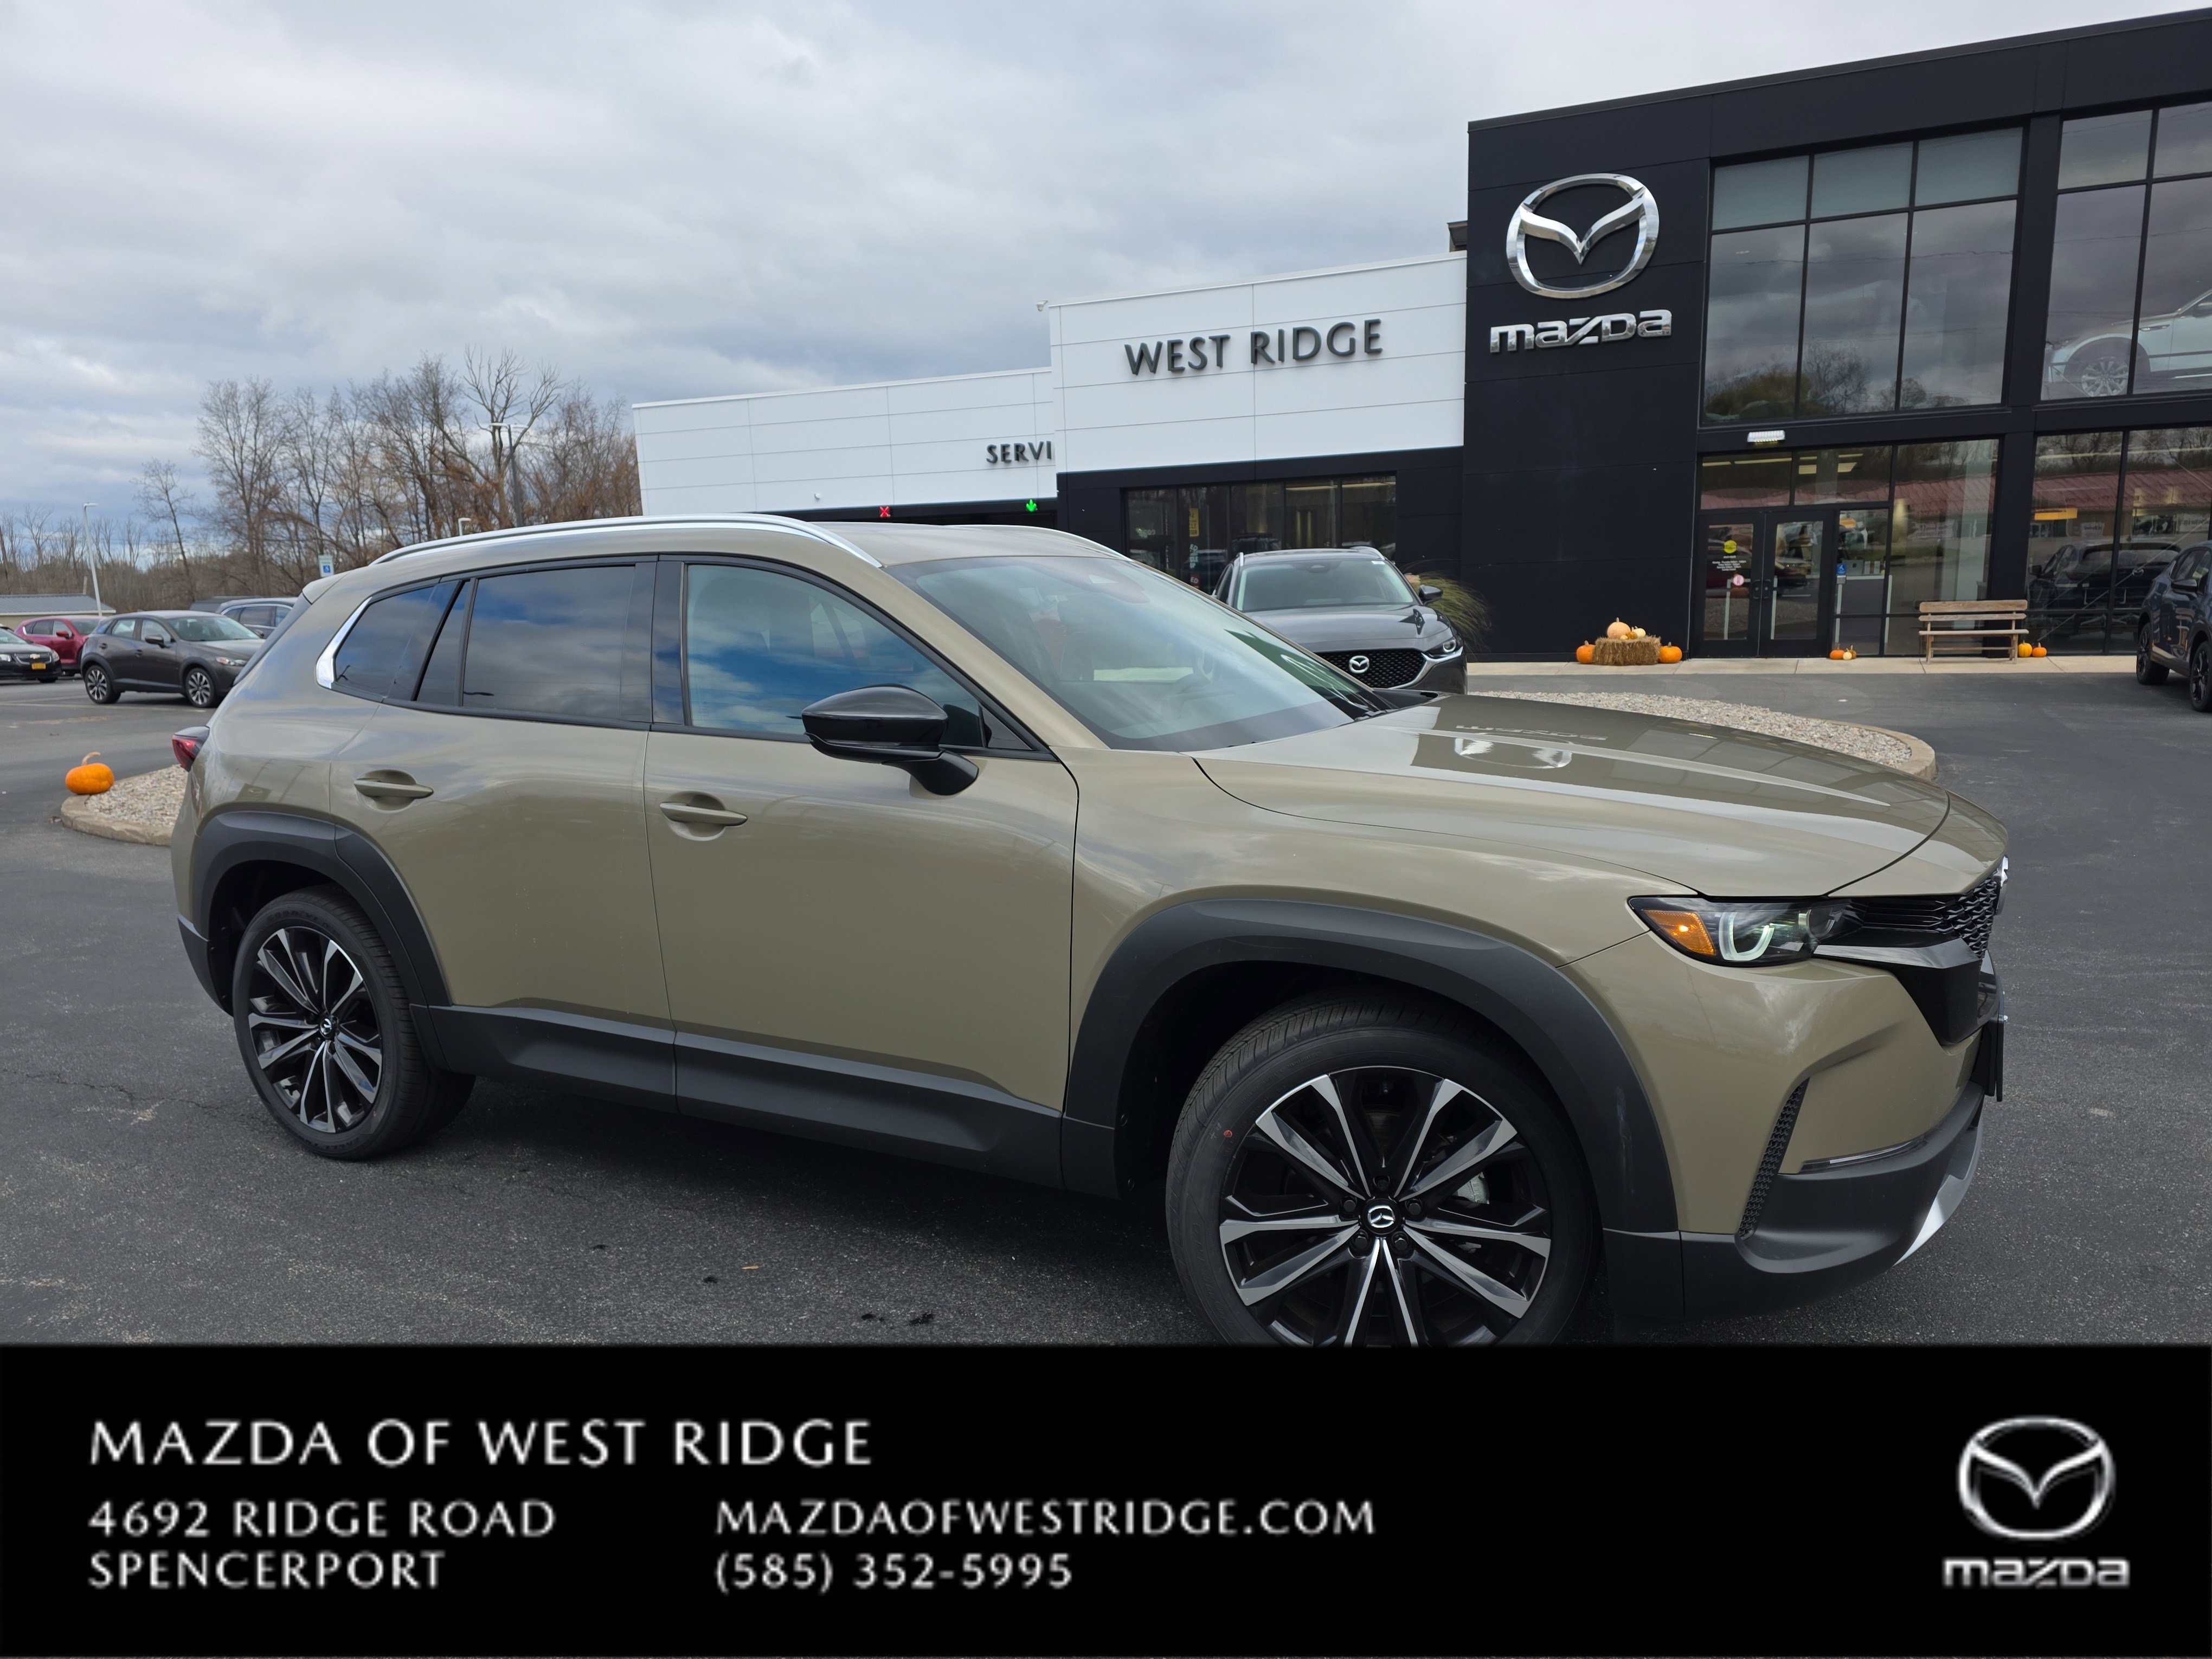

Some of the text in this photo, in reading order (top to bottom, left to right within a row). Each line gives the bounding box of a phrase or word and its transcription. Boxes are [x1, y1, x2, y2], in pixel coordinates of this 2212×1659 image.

[1124, 319, 1383, 375] WEST RIDGE
[1490, 309, 1672, 353] mazda
[986, 440, 1052, 464] SERVI
